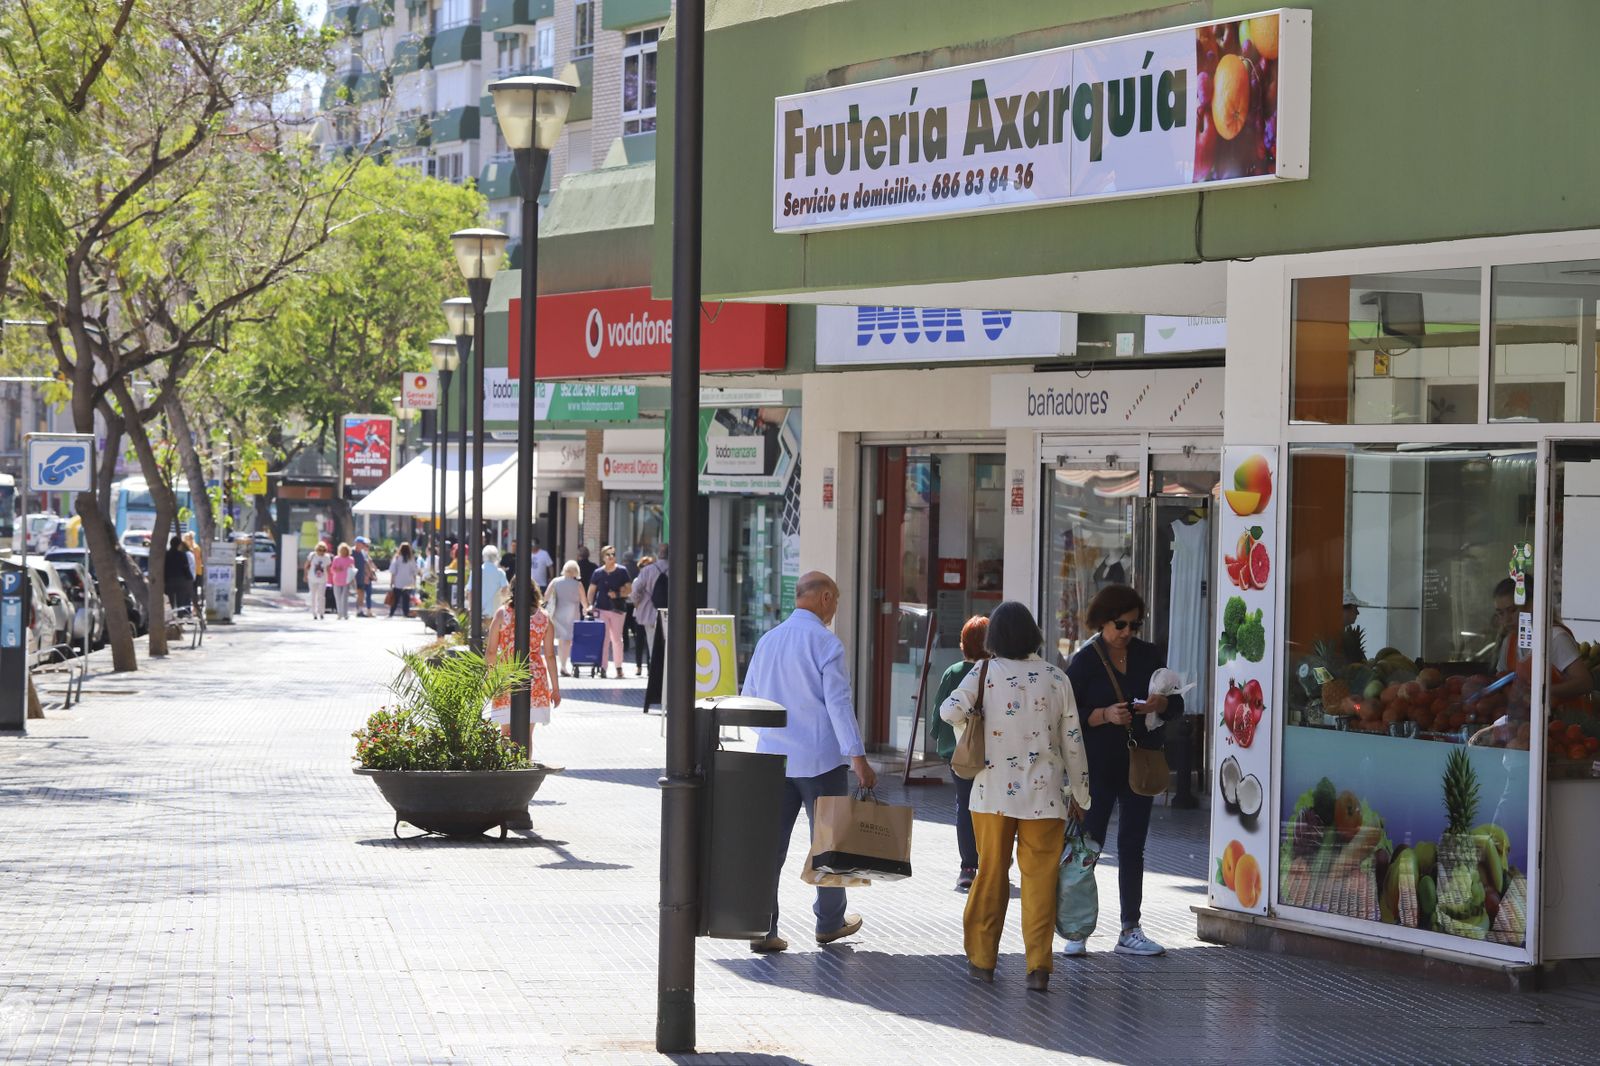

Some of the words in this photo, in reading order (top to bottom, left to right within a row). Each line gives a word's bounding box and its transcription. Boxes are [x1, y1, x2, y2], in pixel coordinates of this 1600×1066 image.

[784, 86, 947, 180] Frutería
[963, 50, 1187, 163] Axarquía
[783, 188, 836, 218] Servicio
[839, 195, 850, 211] a
[931, 170, 960, 200] 686
[964, 168, 985, 197] 83
[988, 165, 1009, 194] 84
[1013, 162, 1035, 190] 36
[607, 312, 672, 347] vodafone
[1027, 386, 1108, 417] bañadores
[716, 443, 757, 459] todomanzana
[612, 460, 637, 473] General
[5, 574, 16, 591] P
[697, 623, 727, 634] TIDOS
